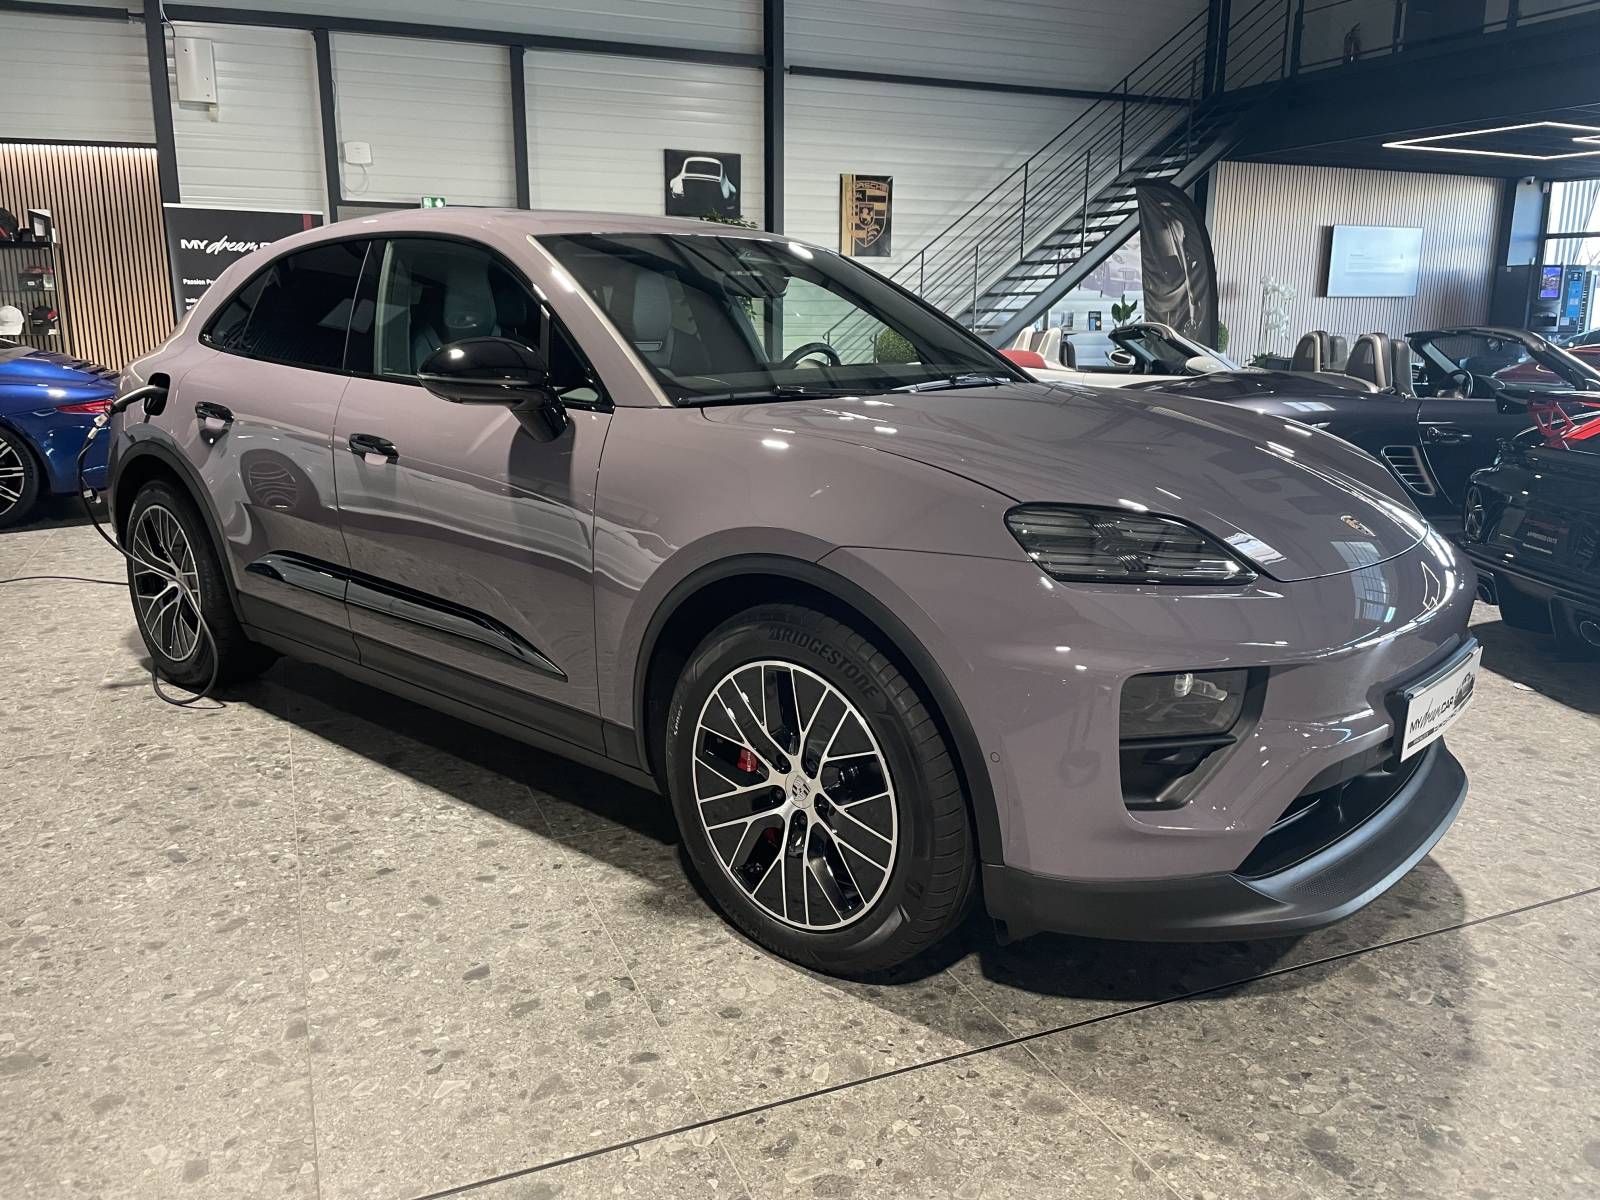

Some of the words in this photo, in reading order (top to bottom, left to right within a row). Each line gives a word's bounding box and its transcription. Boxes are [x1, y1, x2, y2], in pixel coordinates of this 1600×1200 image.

[180, 239, 208, 249] MY
[206, 235, 258, 255] dream
[768, 625, 880, 698] BRIDGESTONE
